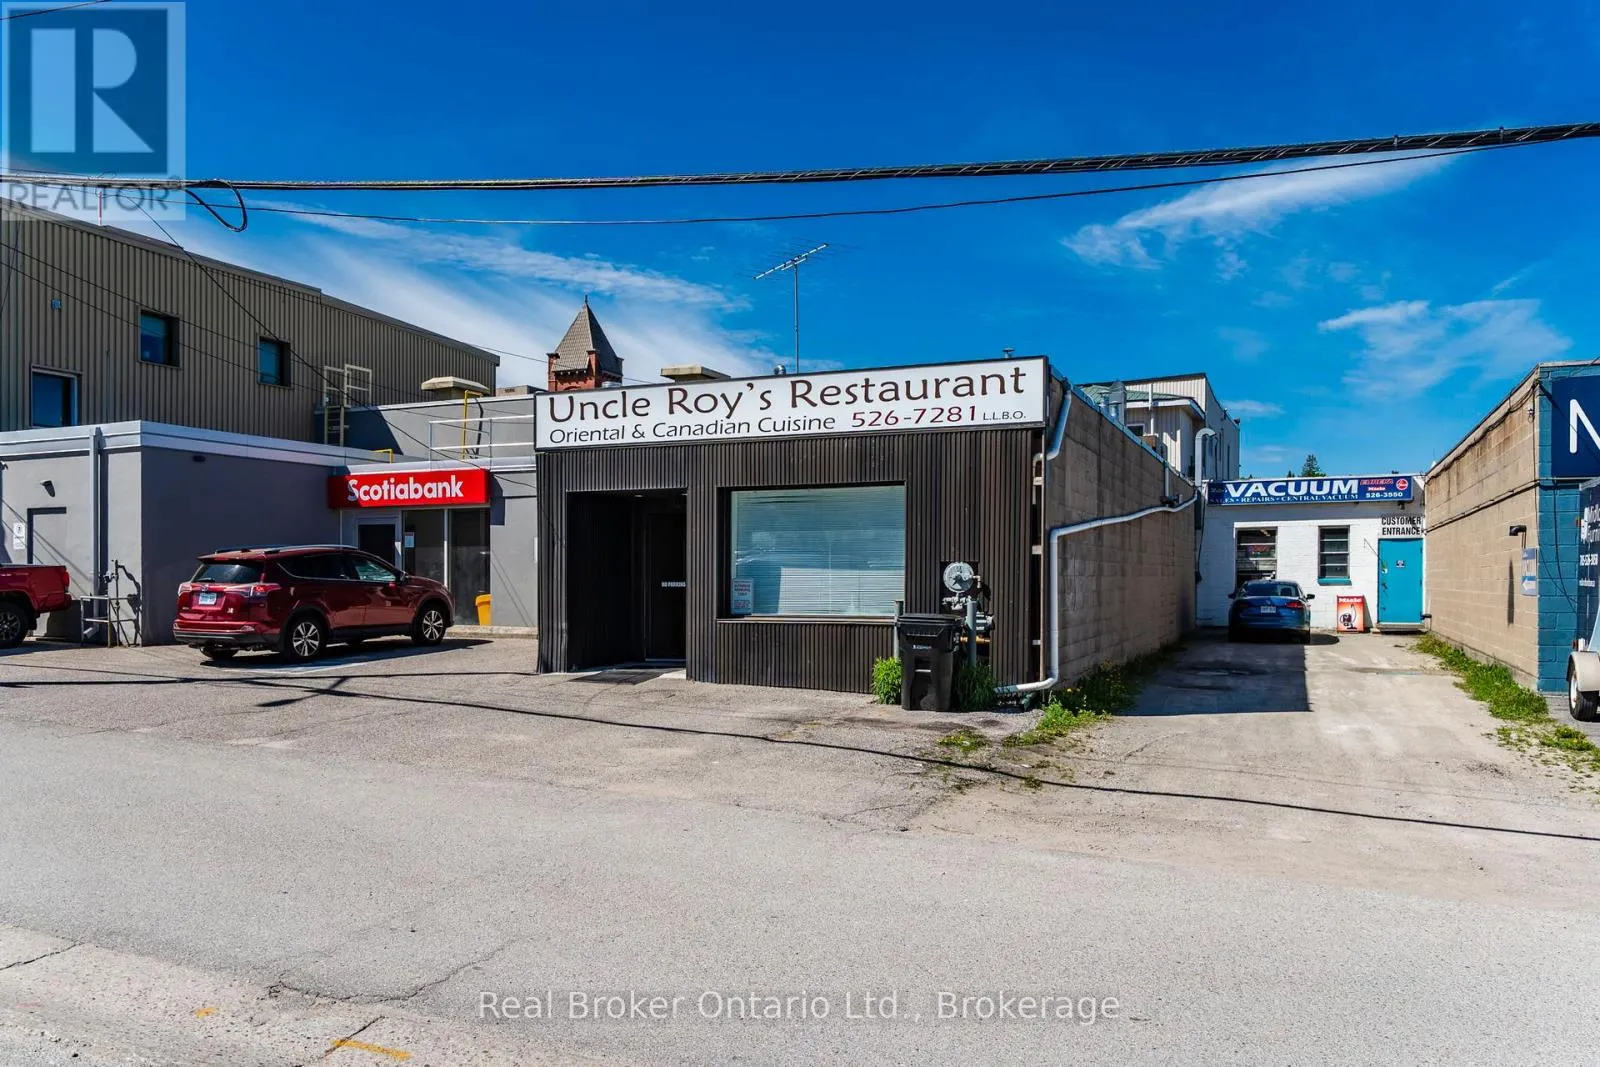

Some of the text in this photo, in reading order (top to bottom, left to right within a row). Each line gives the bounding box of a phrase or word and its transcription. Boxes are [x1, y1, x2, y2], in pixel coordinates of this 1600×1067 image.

[549, 367, 1026, 423] Uncle Roy's Restaurant
[549, 425, 625, 444] Oriental
[632, 424, 645, 439] &
[652, 419, 751, 438] Canadian
[757, 413, 836, 433] Cuisine
[851, 405, 975, 428] 526-7281
[347, 474, 464, 502] Scotiabank
[1226, 480, 1358, 498] VACUUM
[1381, 516, 1421, 526] CUSTOMER
[1382, 526, 1421, 535] ENTRANCE
